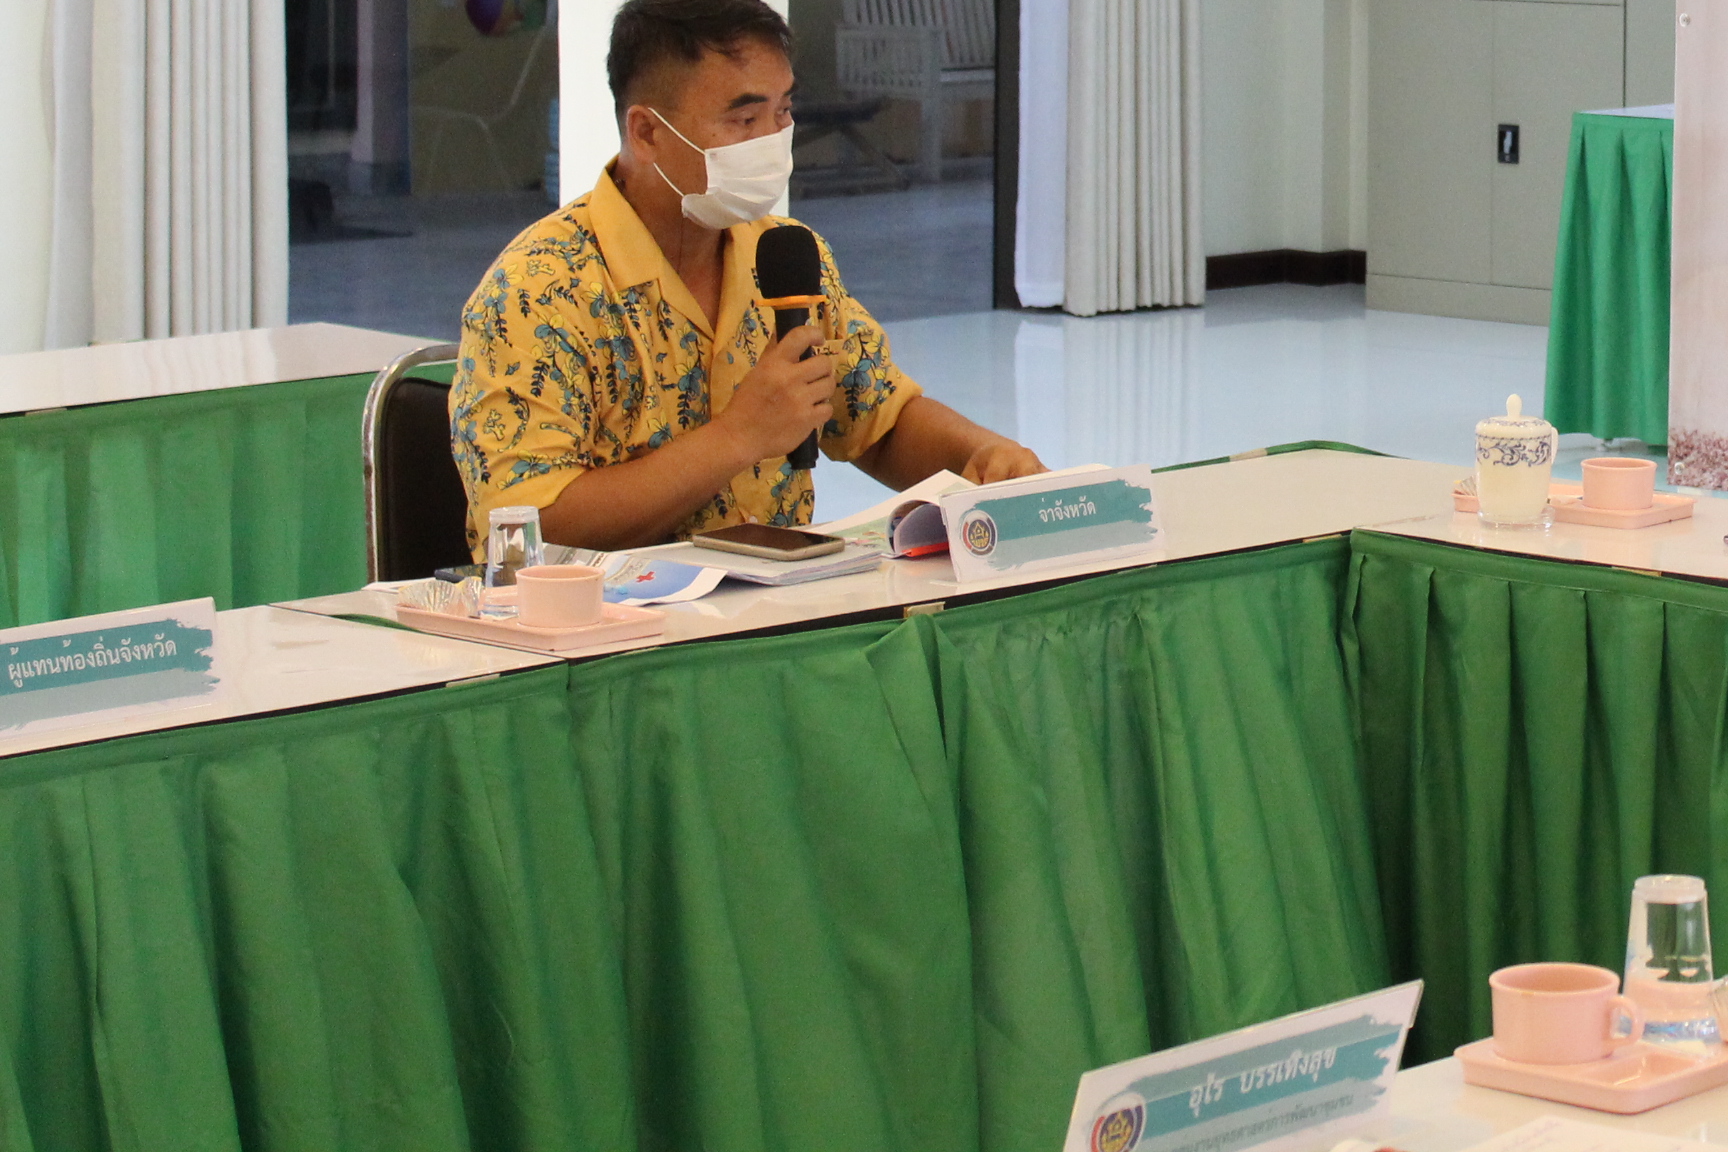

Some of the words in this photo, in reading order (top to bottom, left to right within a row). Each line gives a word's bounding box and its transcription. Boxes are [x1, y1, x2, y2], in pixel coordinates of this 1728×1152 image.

[1038, 495, 1097, 523] จ่าจังหวัด
[8, 632, 178, 689] ผู้แทนท้องถิ่นจังหวัด
[1188, 1072, 1226, 1119] อุไร
